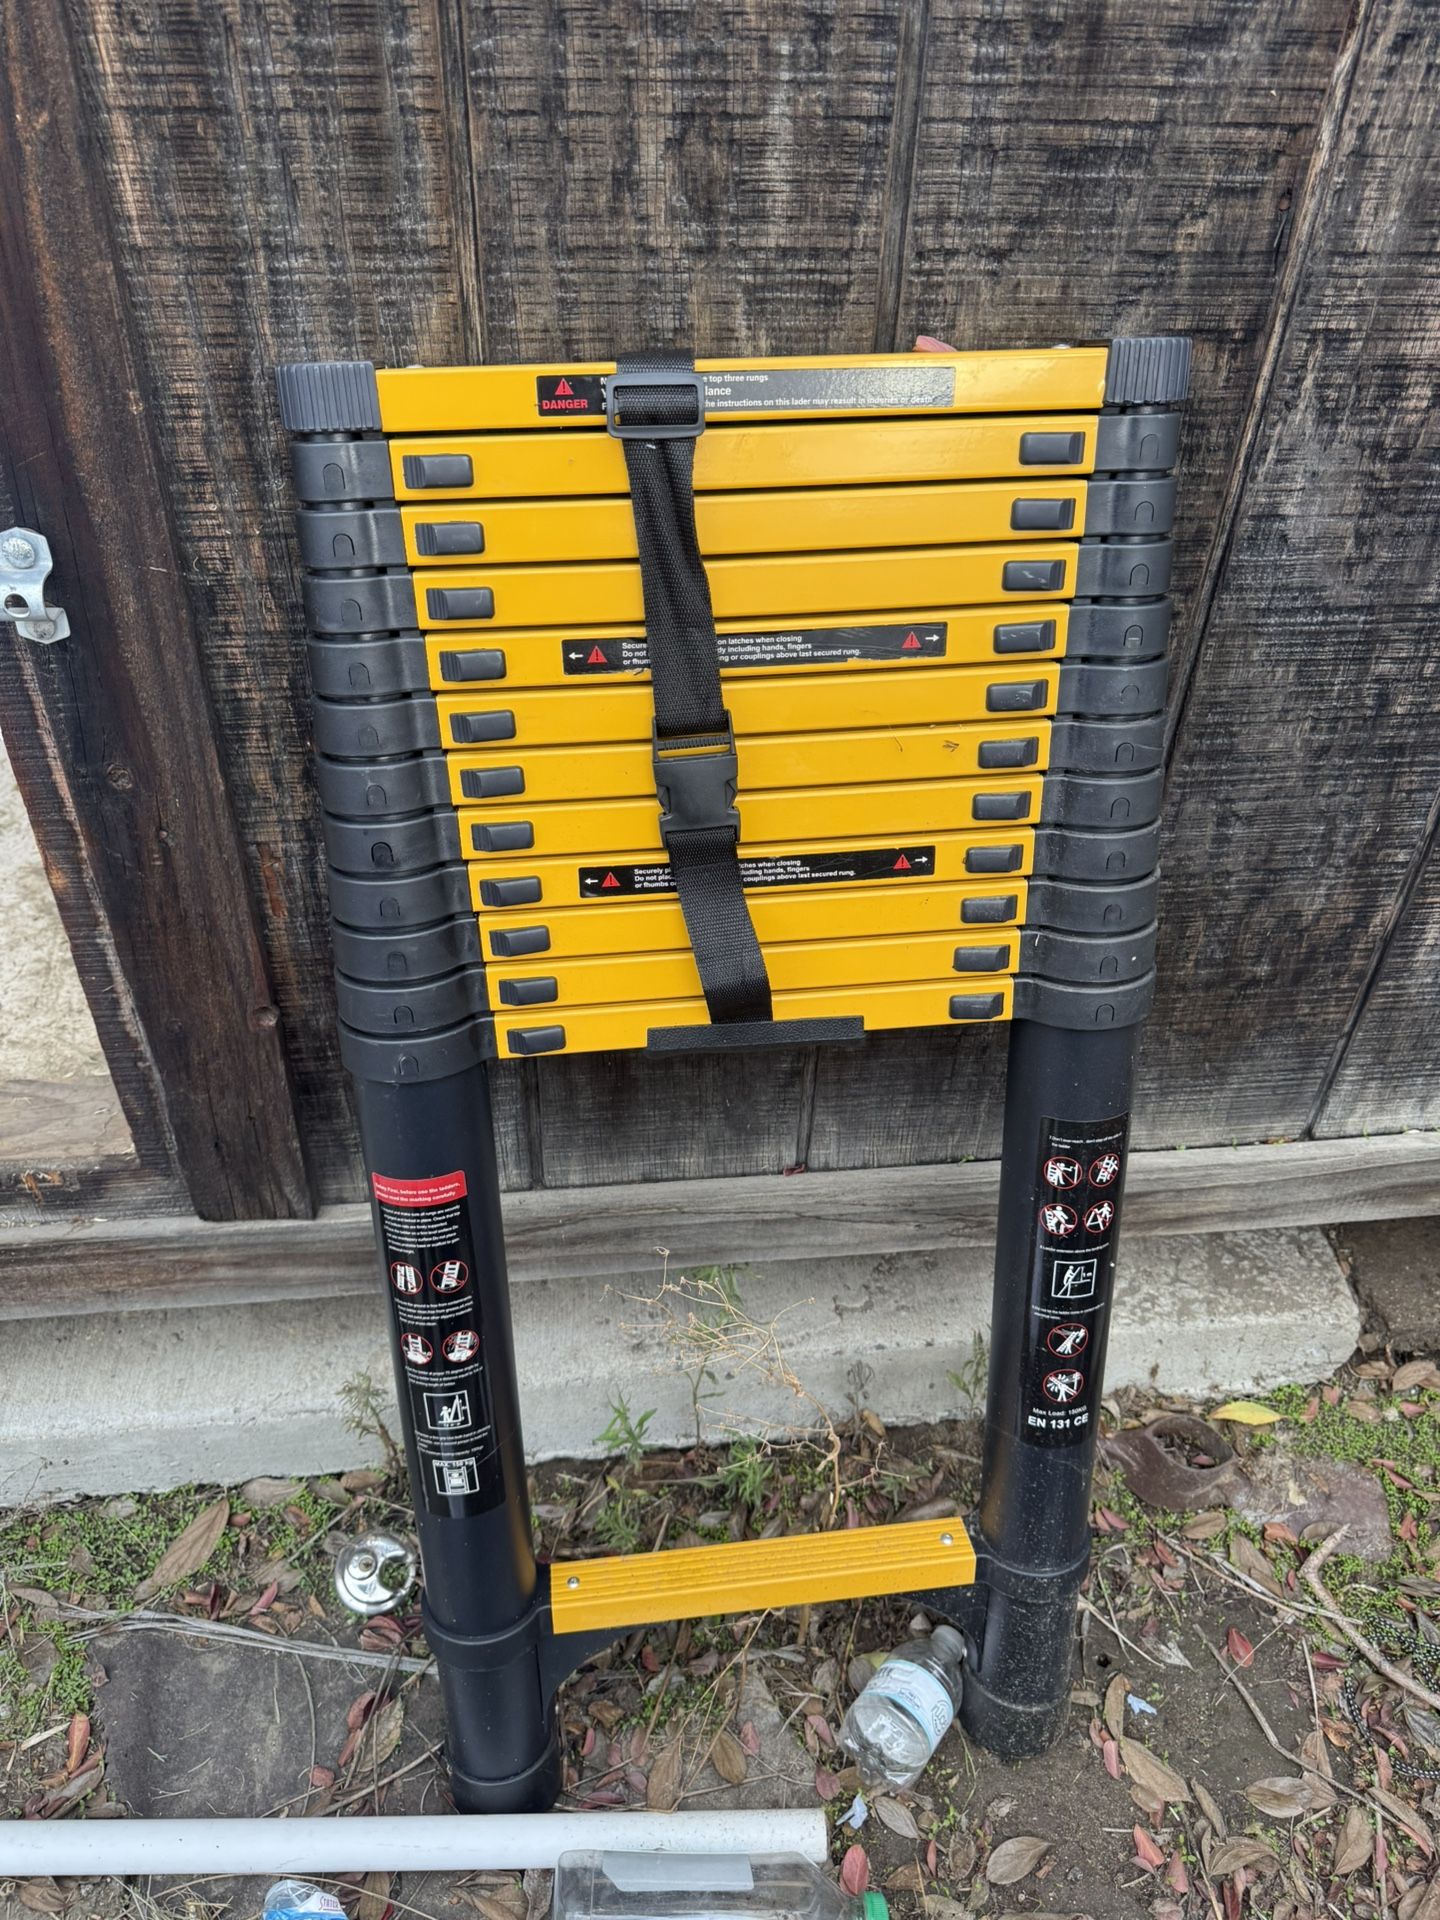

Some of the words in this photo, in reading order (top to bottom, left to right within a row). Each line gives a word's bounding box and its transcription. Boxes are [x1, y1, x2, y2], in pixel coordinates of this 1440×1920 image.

[710, 376, 722, 384] top
[724, 374, 744, 382] three
[746, 374, 768, 383] rungs
[705, 386, 732, 396] lance
[542, 399, 588, 410] DANGER
[717, 398, 762, 407] instructions
[792, 397, 810, 405] lader
[728, 637, 754, 645] latches
[776, 636, 802, 644] closing
[728, 644, 761, 654] including
[740, 652, 774, 661] couplings
[743, 874, 775, 882] couplings
[1028, 1415, 1046, 1428] EN
[1050, 1418, 1070, 1429] 131
[1074, 1412, 1089, 1426] CE
